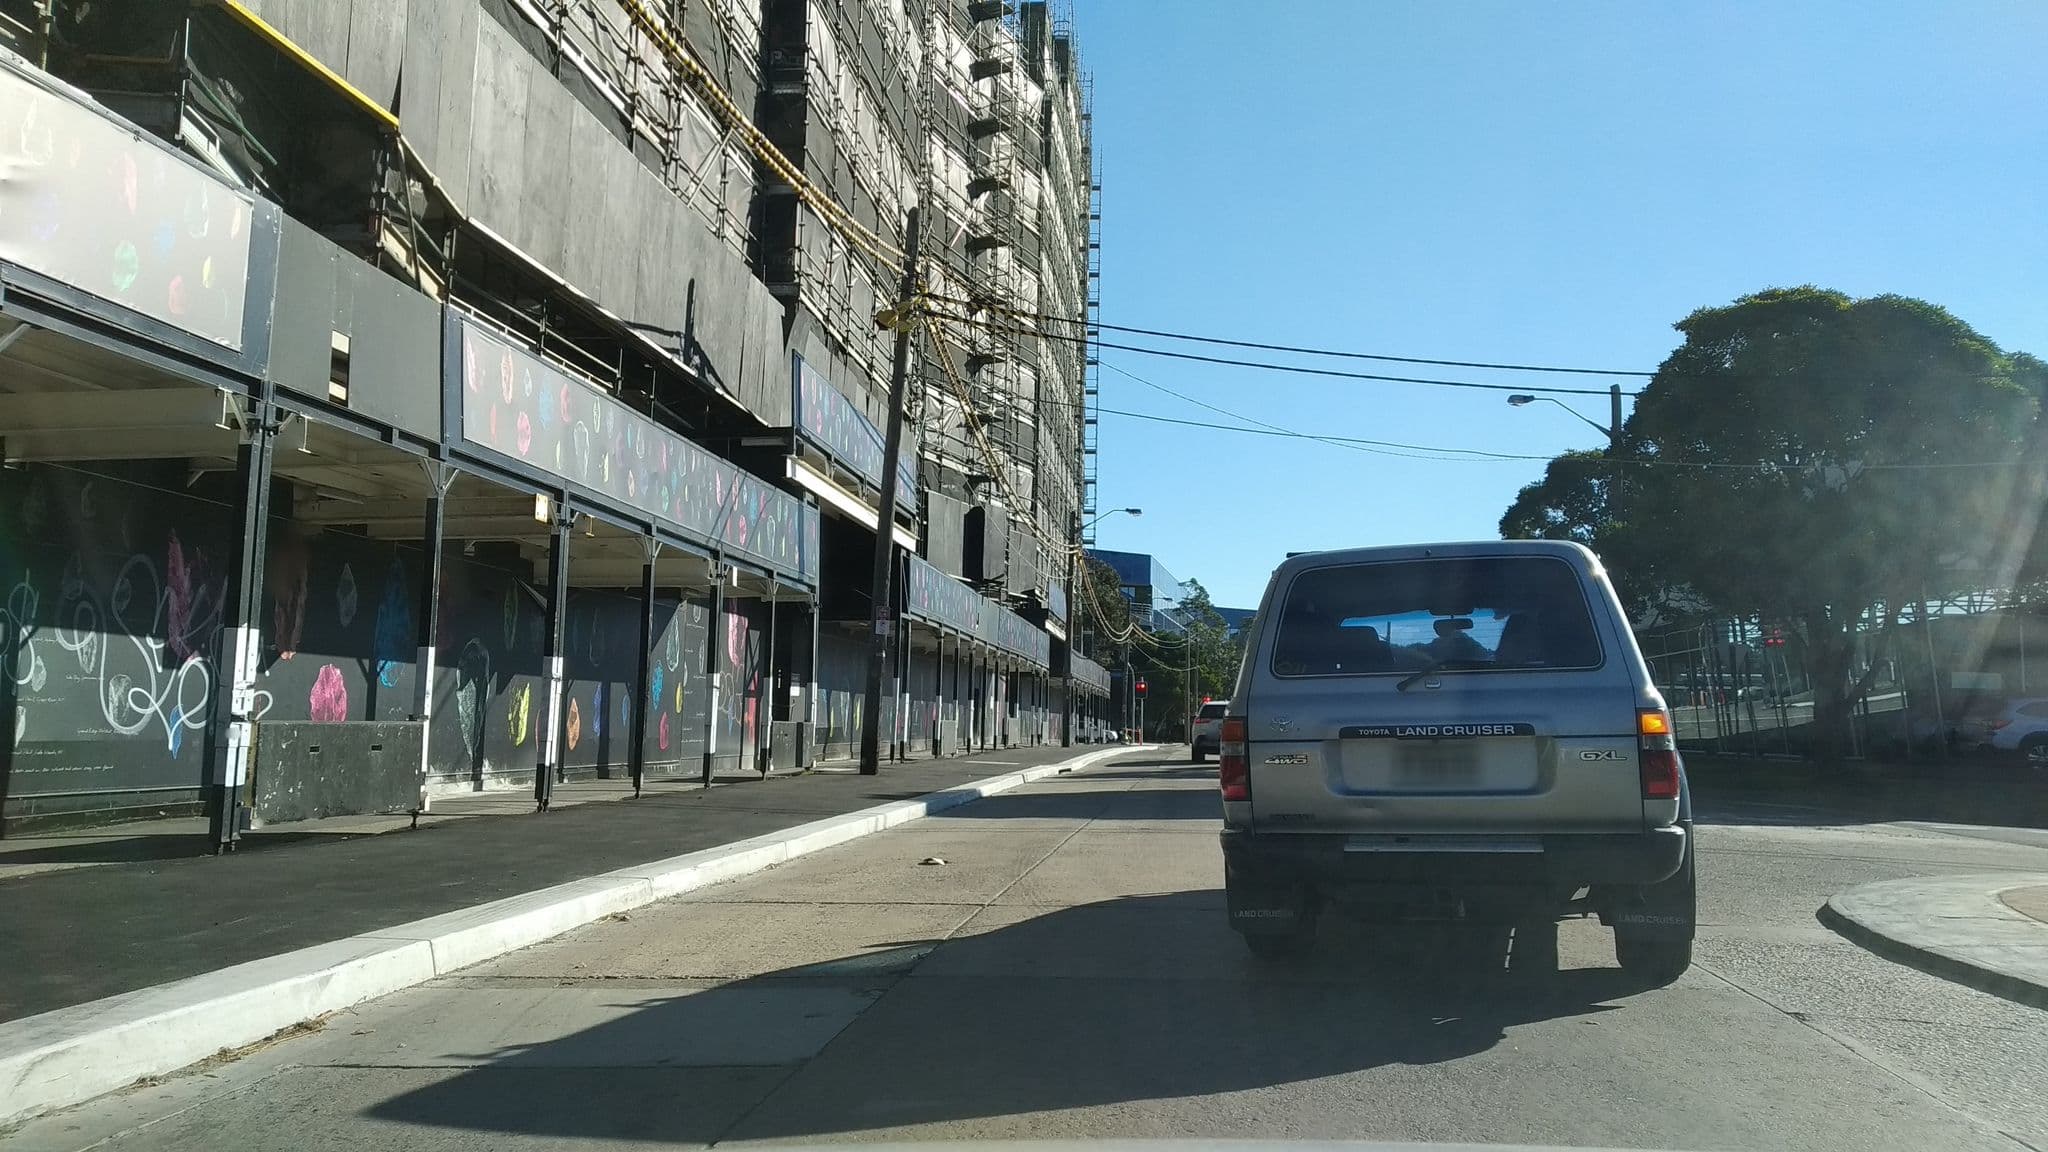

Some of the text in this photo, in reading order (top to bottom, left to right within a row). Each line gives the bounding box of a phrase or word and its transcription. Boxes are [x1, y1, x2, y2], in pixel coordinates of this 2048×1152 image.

[1358, 725, 1515, 736] TOYOTA LAND CRUISER
[1579, 750, 1627, 761] GXL
[1257, 910, 1296, 918] CRUISR
